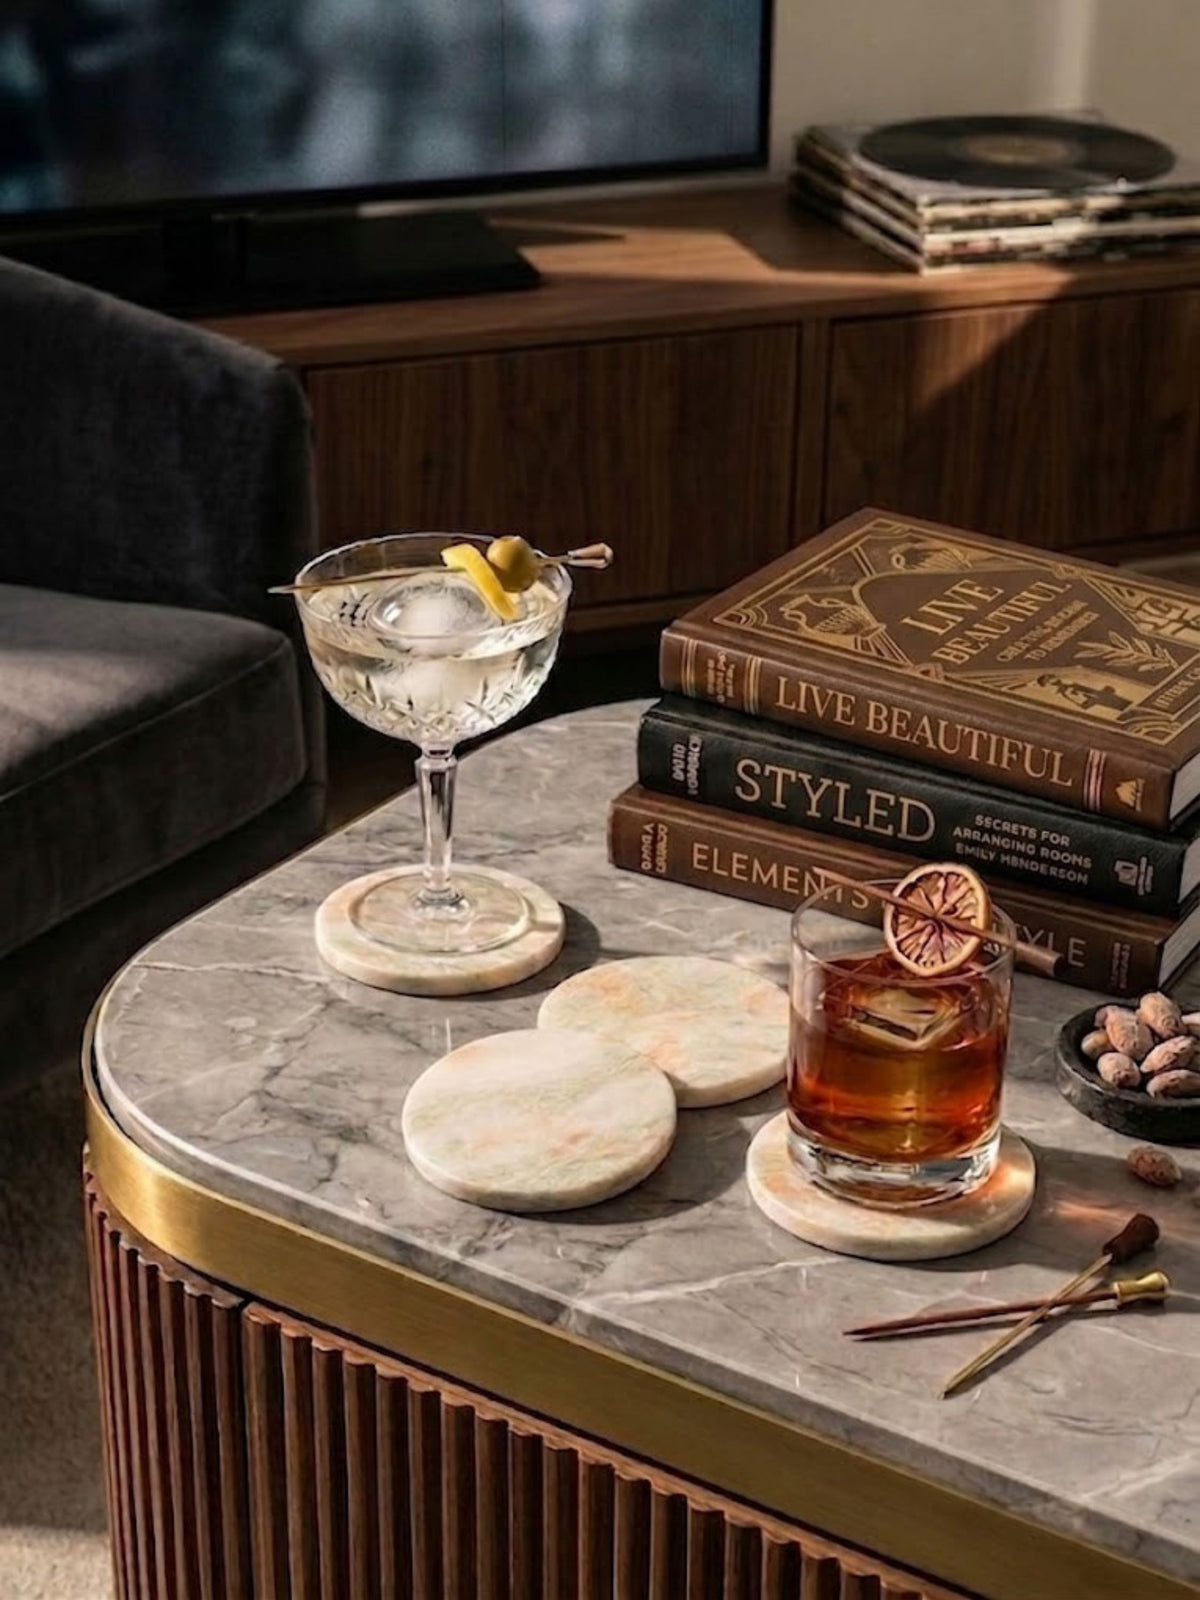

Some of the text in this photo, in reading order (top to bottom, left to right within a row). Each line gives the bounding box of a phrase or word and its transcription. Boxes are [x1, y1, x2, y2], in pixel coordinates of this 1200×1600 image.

[901, 579, 1004, 635] LIVE
[932, 581, 1072, 664] BEAUTIFUL
[776, 676, 855, 725] LIVE
[866, 701, 1072, 786] BEAUTIFUL
[735, 759, 935, 842] STYLED
[953, 826, 1092, 869] ARRANGING ROOMS
[975, 814, 1070, 847] SECRETS FOR
[955, 842, 1088, 885] EMILY HENDERSON
